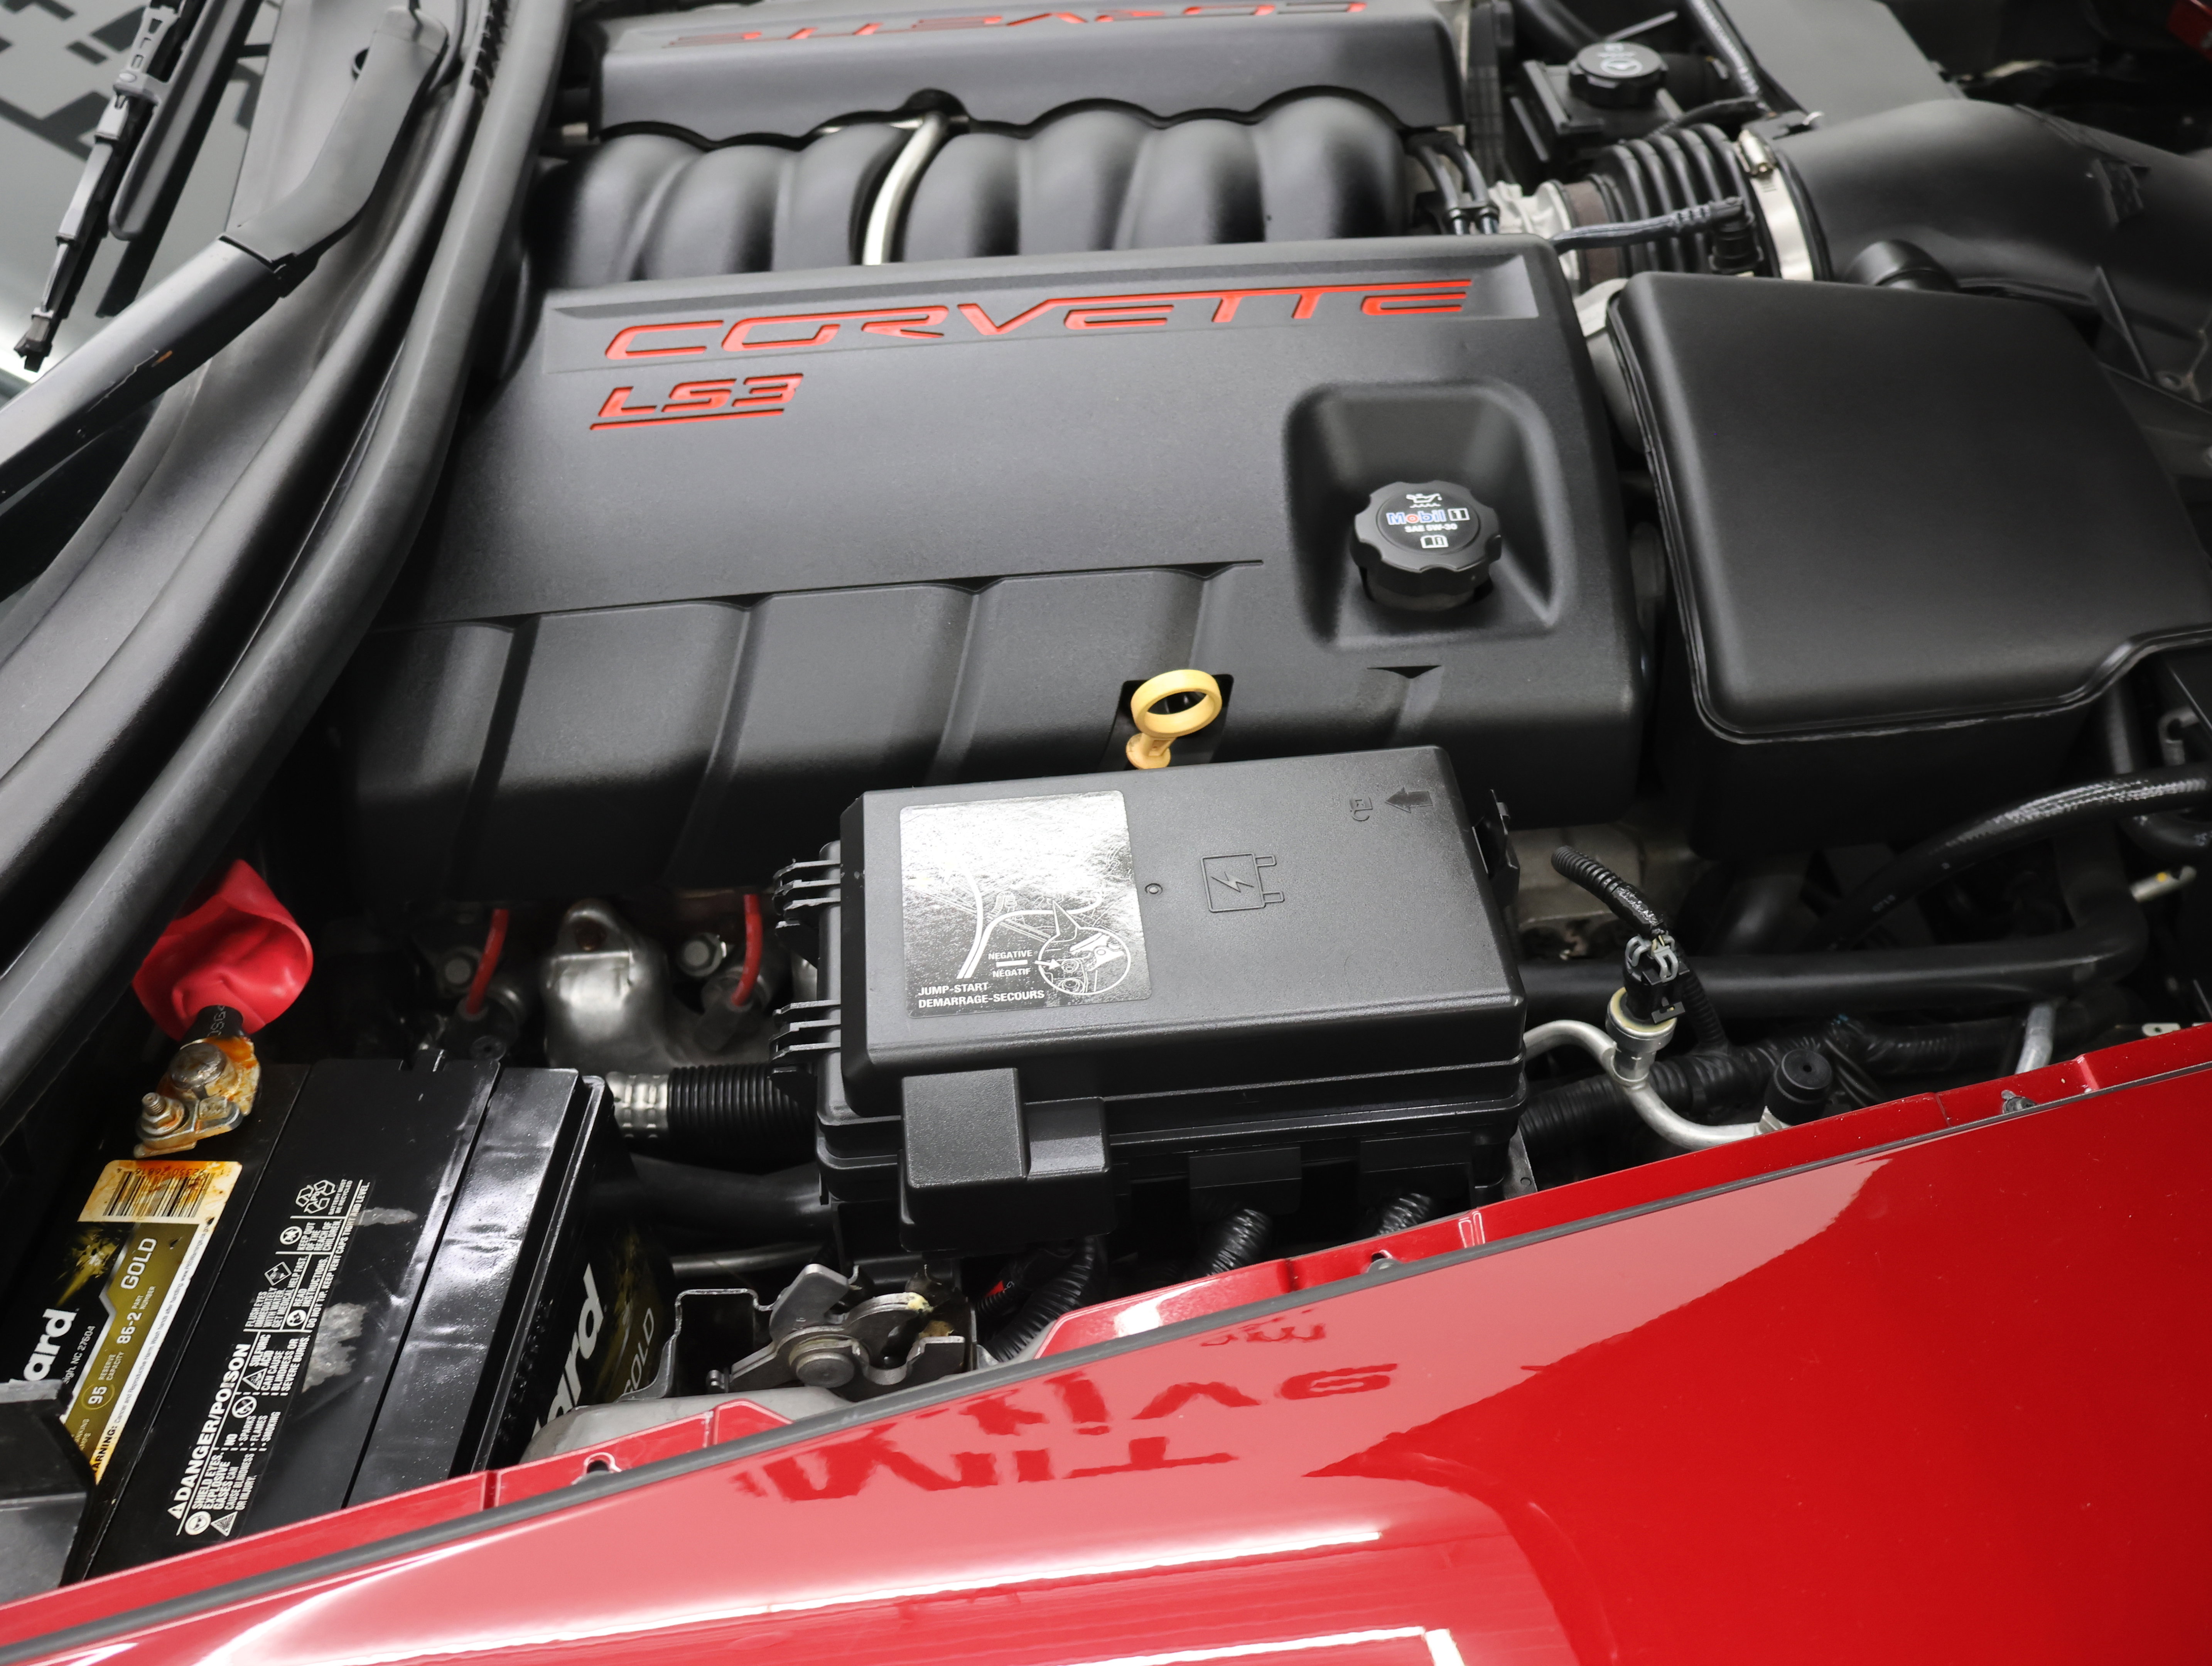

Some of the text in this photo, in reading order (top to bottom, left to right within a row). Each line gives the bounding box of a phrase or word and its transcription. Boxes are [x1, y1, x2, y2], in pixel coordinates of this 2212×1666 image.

[605, 280, 1472, 361] CORVETTE
[599, 373, 803, 417] LS3
[1386, 509, 1447, 525] Mobil
[988, 949, 1033, 960] NEGATIVE
[918, 982, 989, 996] JUMP-START
[918, 990, 1045, 1008] DEMARRAGE-SECOURS
[328, 1179, 347, 1215] BATTERY MUST
[338, 1180, 353, 1206] RECYCLED
[296, 1222, 316, 1251] KEEP OUT
[305, 1230, 322, 1251] OF THE
[313, 1221, 333, 1251] REACH OF
[322, 1219, 343, 1251] CHILDREN.
[120, 1238, 157, 1289] GOLD
[306, 1182, 371, 1328] DO NOT TIP. KEEP VENT CAPS TIGHT AND LEVEL.
[139, 1286, 157, 1309] NUMBER
[271, 1256, 308, 1328] GET MEDICAL HELP FAST.
[292, 1288, 308, 1307] READ
[301, 1257, 329, 1307] INSTRUCTIONS.
[131, 1295, 144, 1309] PART
[245, 1291, 268, 1327] FLUSH EYES
[253, 1287, 278, 1327] IMMEDIATELY
[262, 1288, 287, 1328] WITH WATER.
[70, 1352, 83, 1364] NC
[77, 1326, 95, 1351] 27604
[116, 1312, 142, 1344] 86-2
[9, 1309, 77, 1384] ard
[249, 1334, 271, 1367] SULFURIC
[259, 1350, 275, 1367] ACID
[281, 1335, 311, 1391] SEVERE BURNS.
[98, 1354, 116, 1380] RESERVE
[106, 1351, 125, 1380] CAPACITY
[261, 1350, 285, 1391] CAN CAUSE
[270, 1338, 300, 1391] BLINDNESS OR
[88, 1386, 107, 1404] 95
[174, 1344, 251, 1501] DANGER/POISON
[223, 1433, 238, 1446] NO
[238, 1415, 257, 1442] SPARKS
[250, 1415, 268, 1442] FLAMES
[261, 1411, 281, 1442] SMOKING
[92, 1426, 117, 1474] ARNING:
[191, 1452, 224, 1509] SHIELD EYES.
[202, 1461, 231, 1509] EXPLOSIVE
[213, 1466, 240, 1509] GASES CAN
[224, 1453, 255, 1510] CAUSE BLINDNESS
[235, 1475, 257, 1510] OR INJURY.
